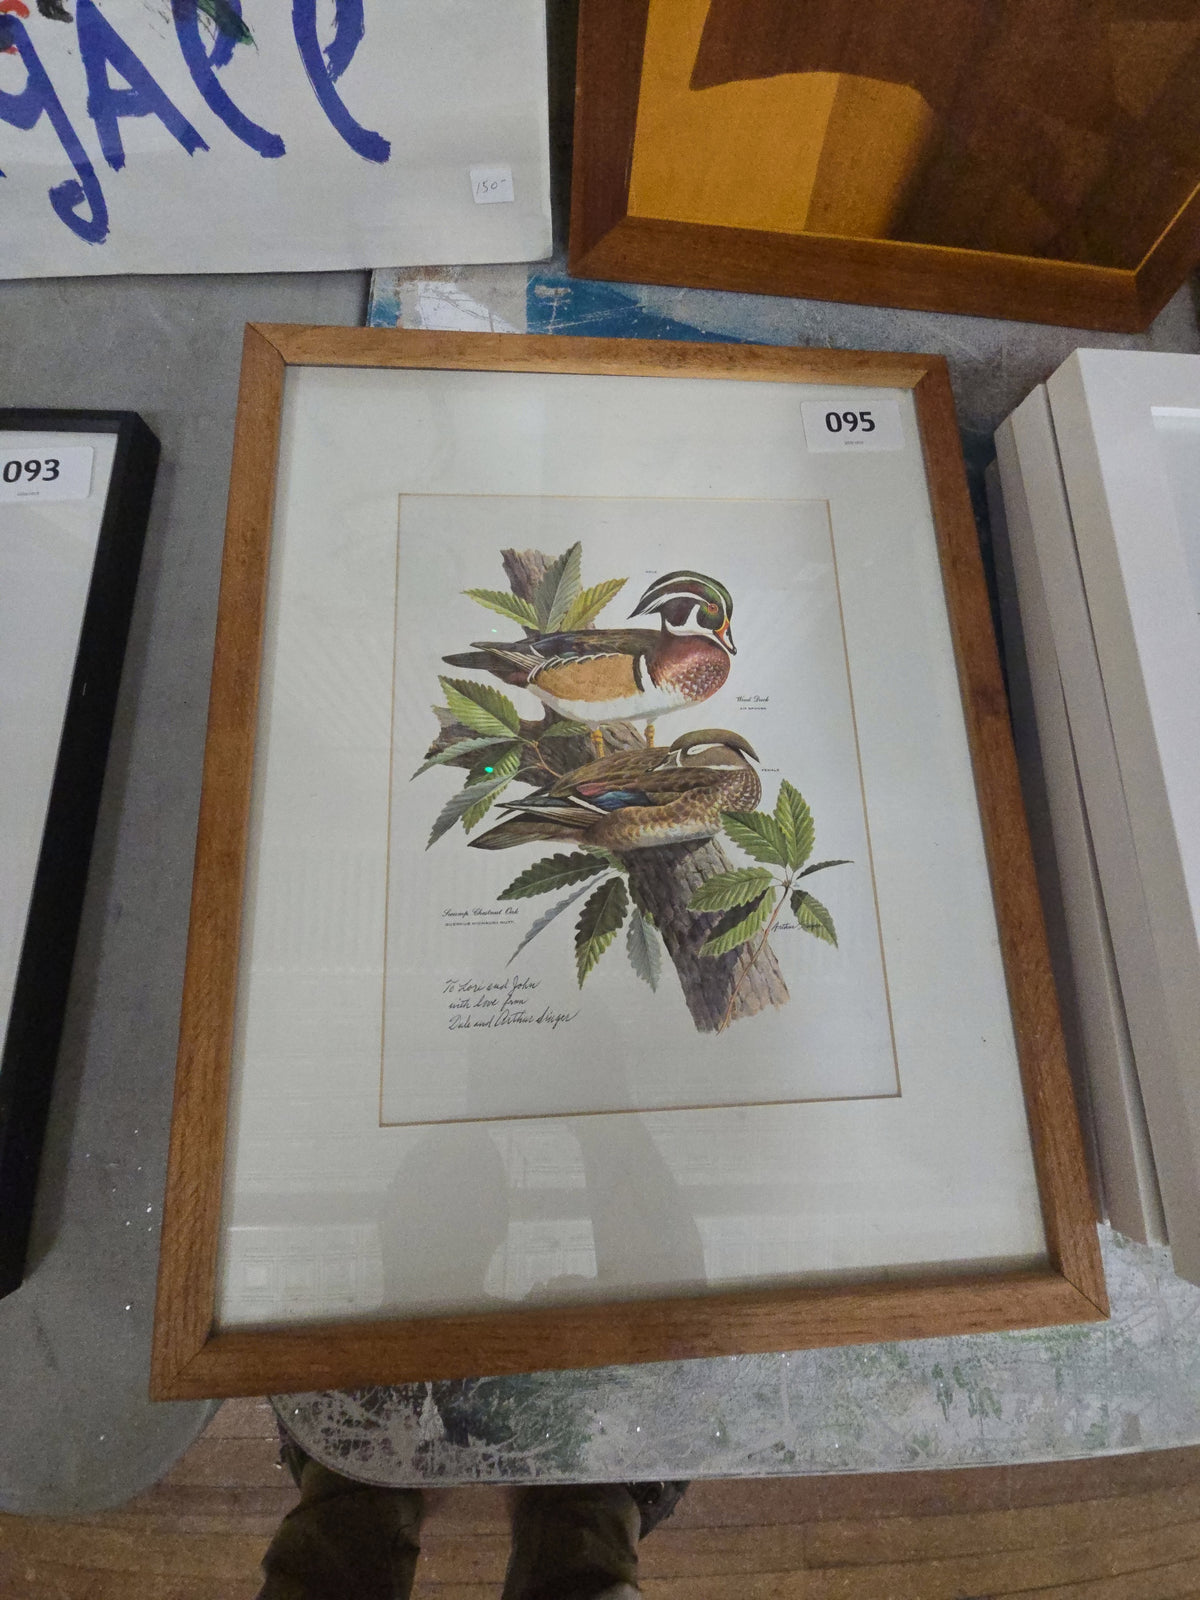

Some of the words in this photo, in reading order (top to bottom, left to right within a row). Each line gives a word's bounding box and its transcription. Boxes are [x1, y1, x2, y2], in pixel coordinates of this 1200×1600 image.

[825, 411, 876, 433] 095
[3, 458, 60, 483] 093
[442, 909, 468, 918] Swamp
[472, 907, 502, 916] Chestnut
[505, 906, 519, 915] Oak
